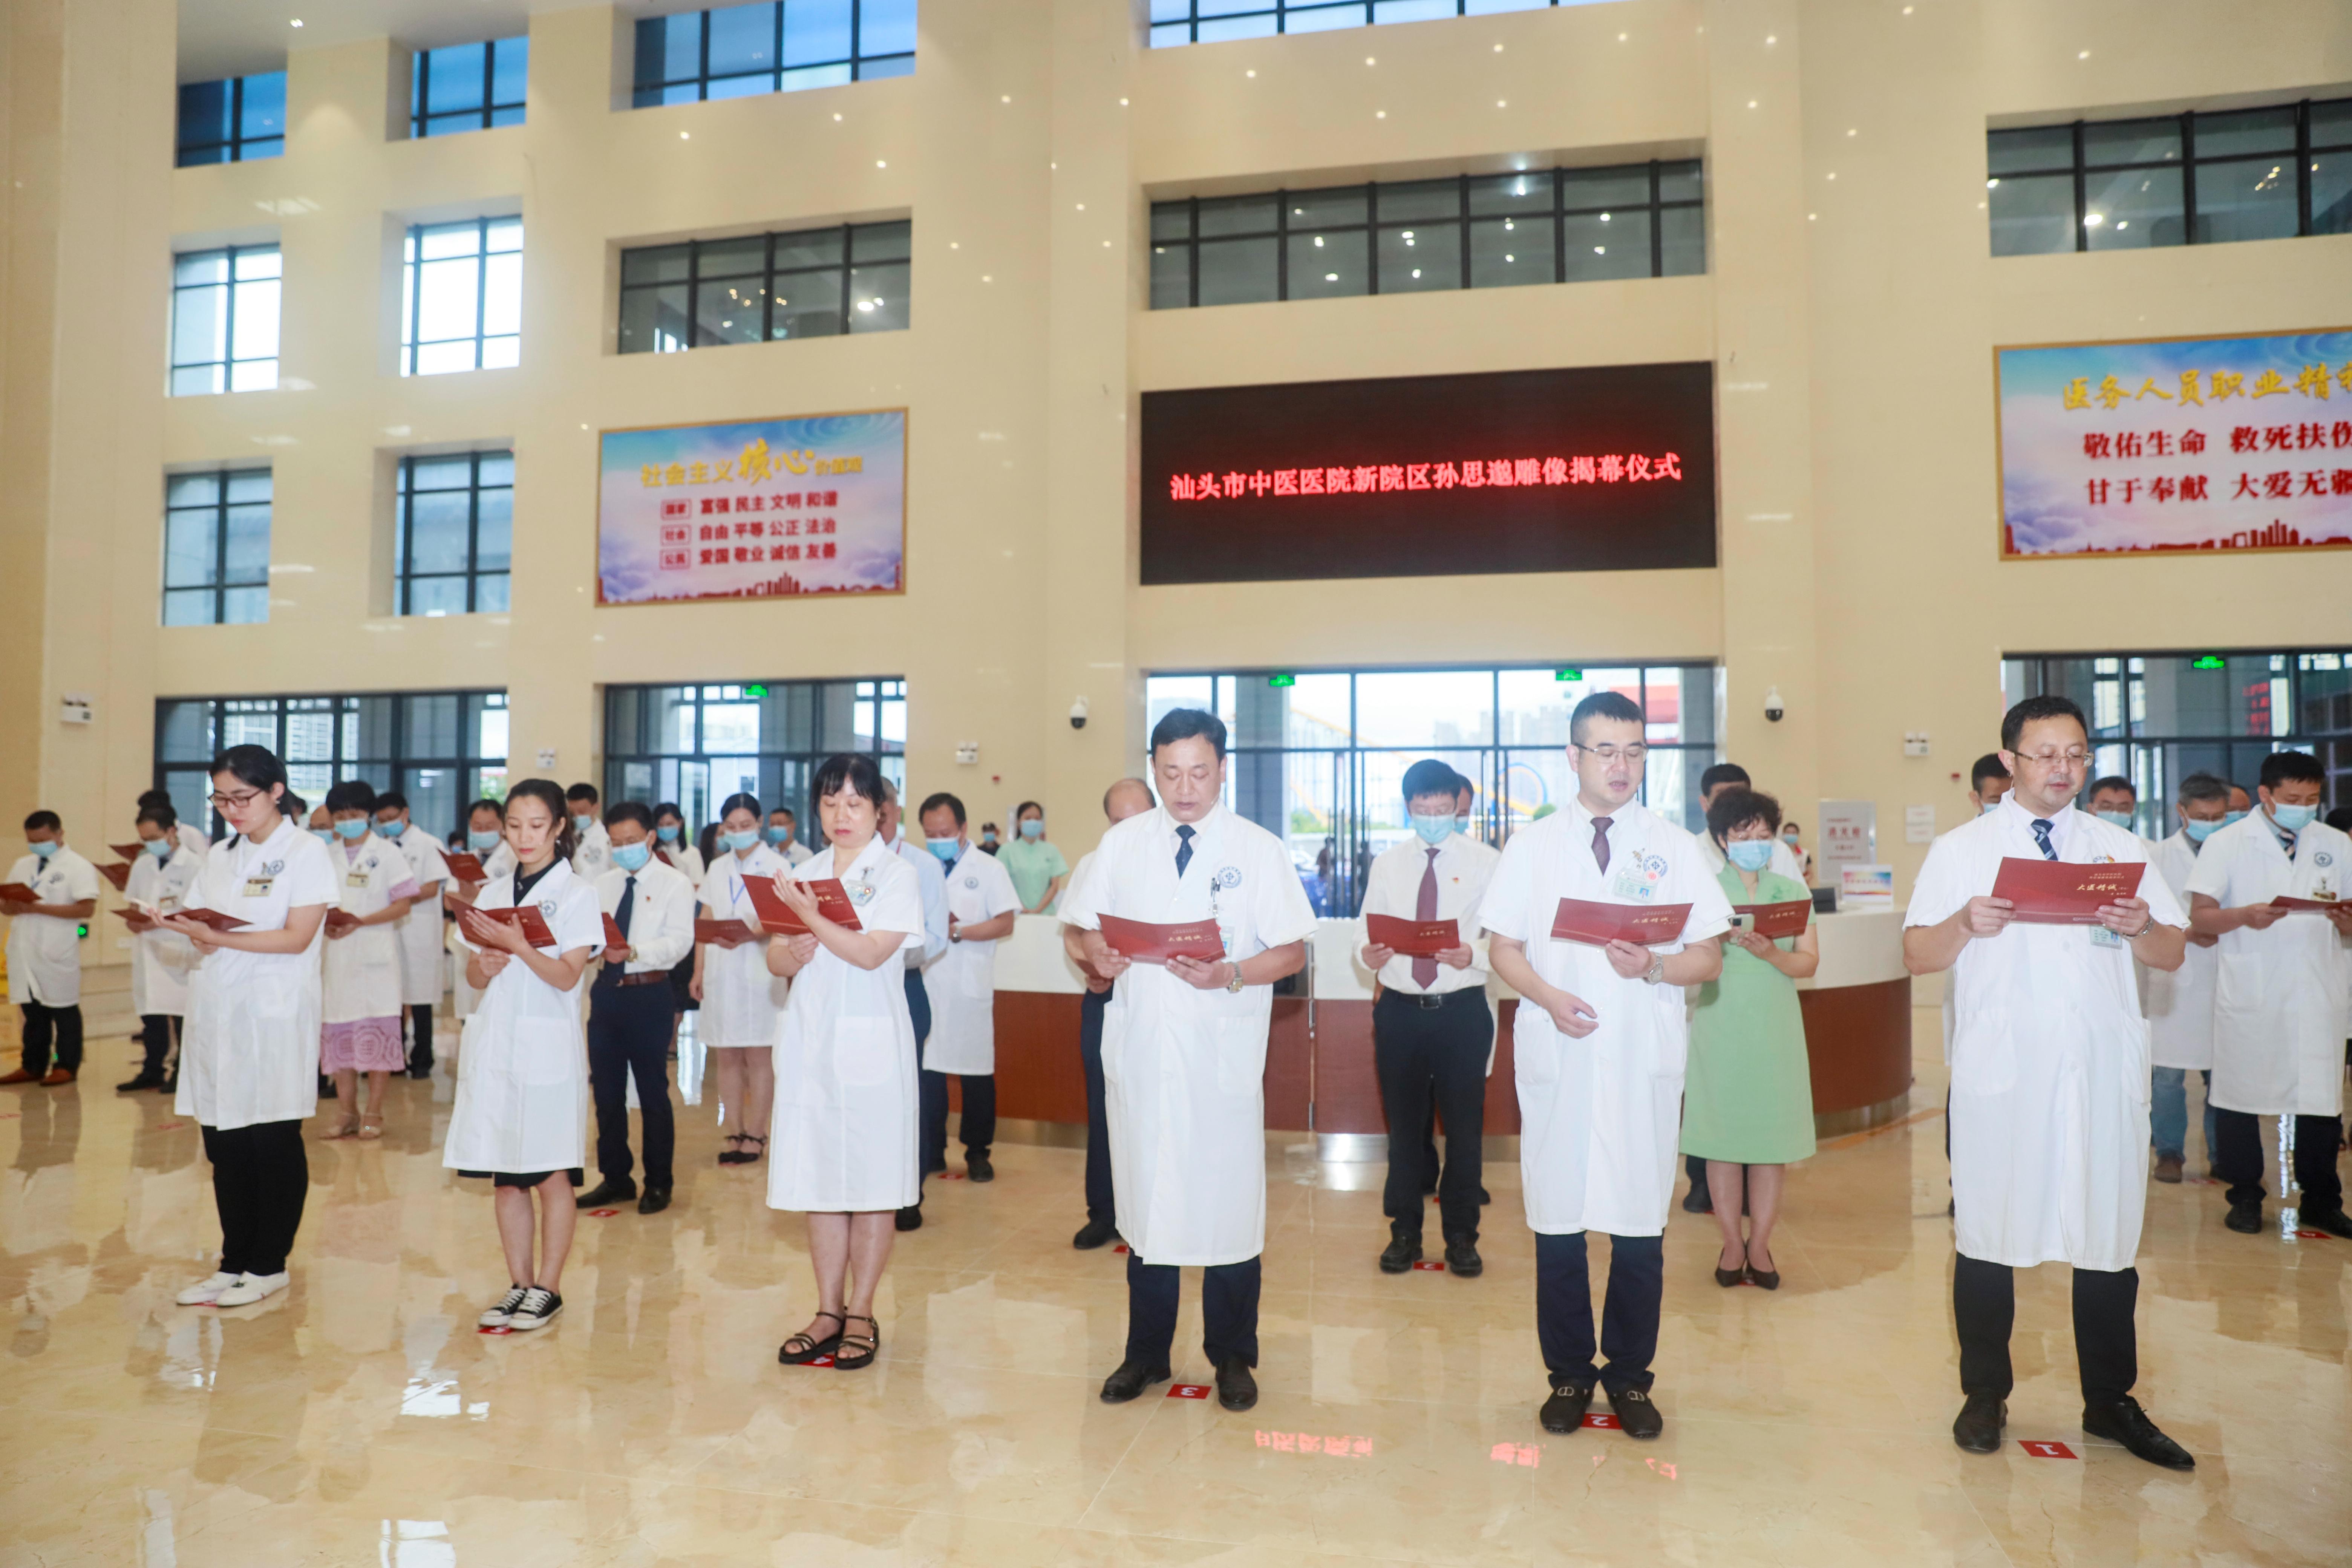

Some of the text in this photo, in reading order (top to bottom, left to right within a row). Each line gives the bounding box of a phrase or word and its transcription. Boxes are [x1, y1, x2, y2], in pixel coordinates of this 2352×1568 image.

[2083, 421, 2352, 459] 敬佑生命 救死扶伤
[1170, 452, 1681, 501] 汕头市中医医院新院区孙思邈雕像揭幕仪式
[2085, 469, 2352, 505] 甘于奉献 大爱无疆
[735, 496, 764, 512] 民主
[770, 493, 801, 510] 文明
[700, 524, 728, 541] 自由
[735, 521, 764, 538] 平等
[770, 519, 799, 536] 公正
[805, 517, 836, 534] 法治
[770, 544, 800, 561] 诚信
[1181, 1387, 1199, 1396] 3
[1591, 1416, 1608, 1426] 2
[2036, 1444, 2058, 1455] 1
